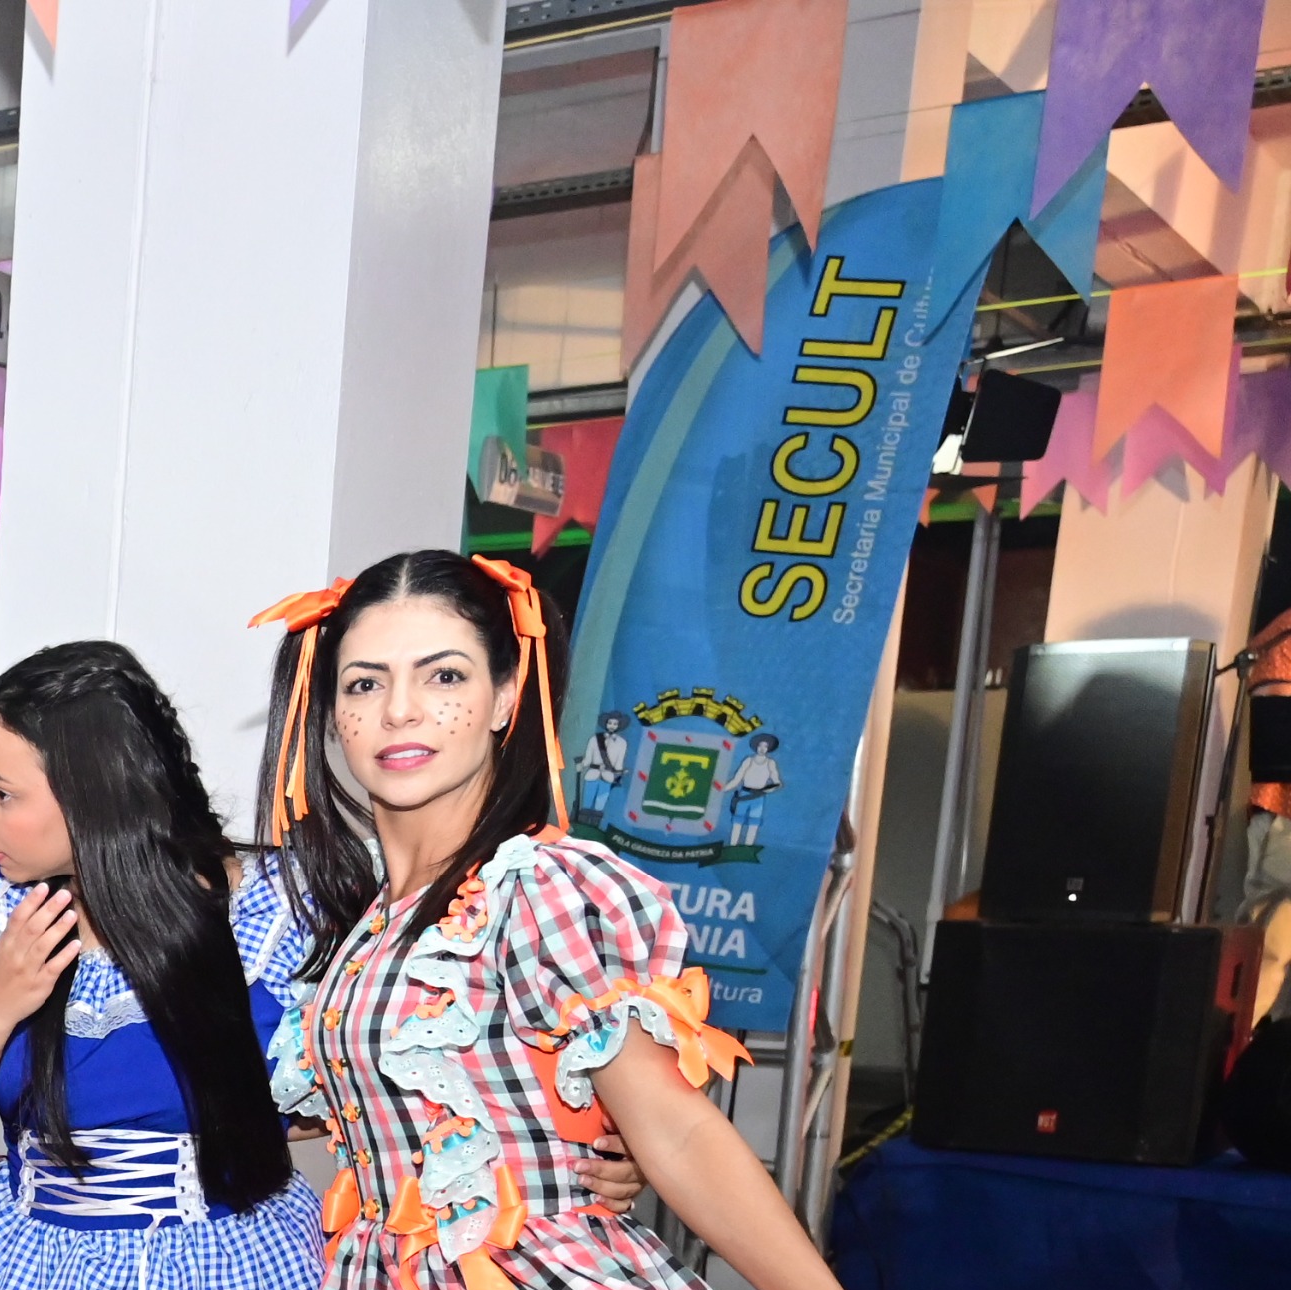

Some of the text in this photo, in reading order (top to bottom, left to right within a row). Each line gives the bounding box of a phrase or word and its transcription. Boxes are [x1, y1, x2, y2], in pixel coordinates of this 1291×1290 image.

[739, 255, 907, 622] SECULT
[832, 508, 882, 625] Secretaria
[863, 391, 911, 501] Municipal
[896, 355, 922, 385] de
